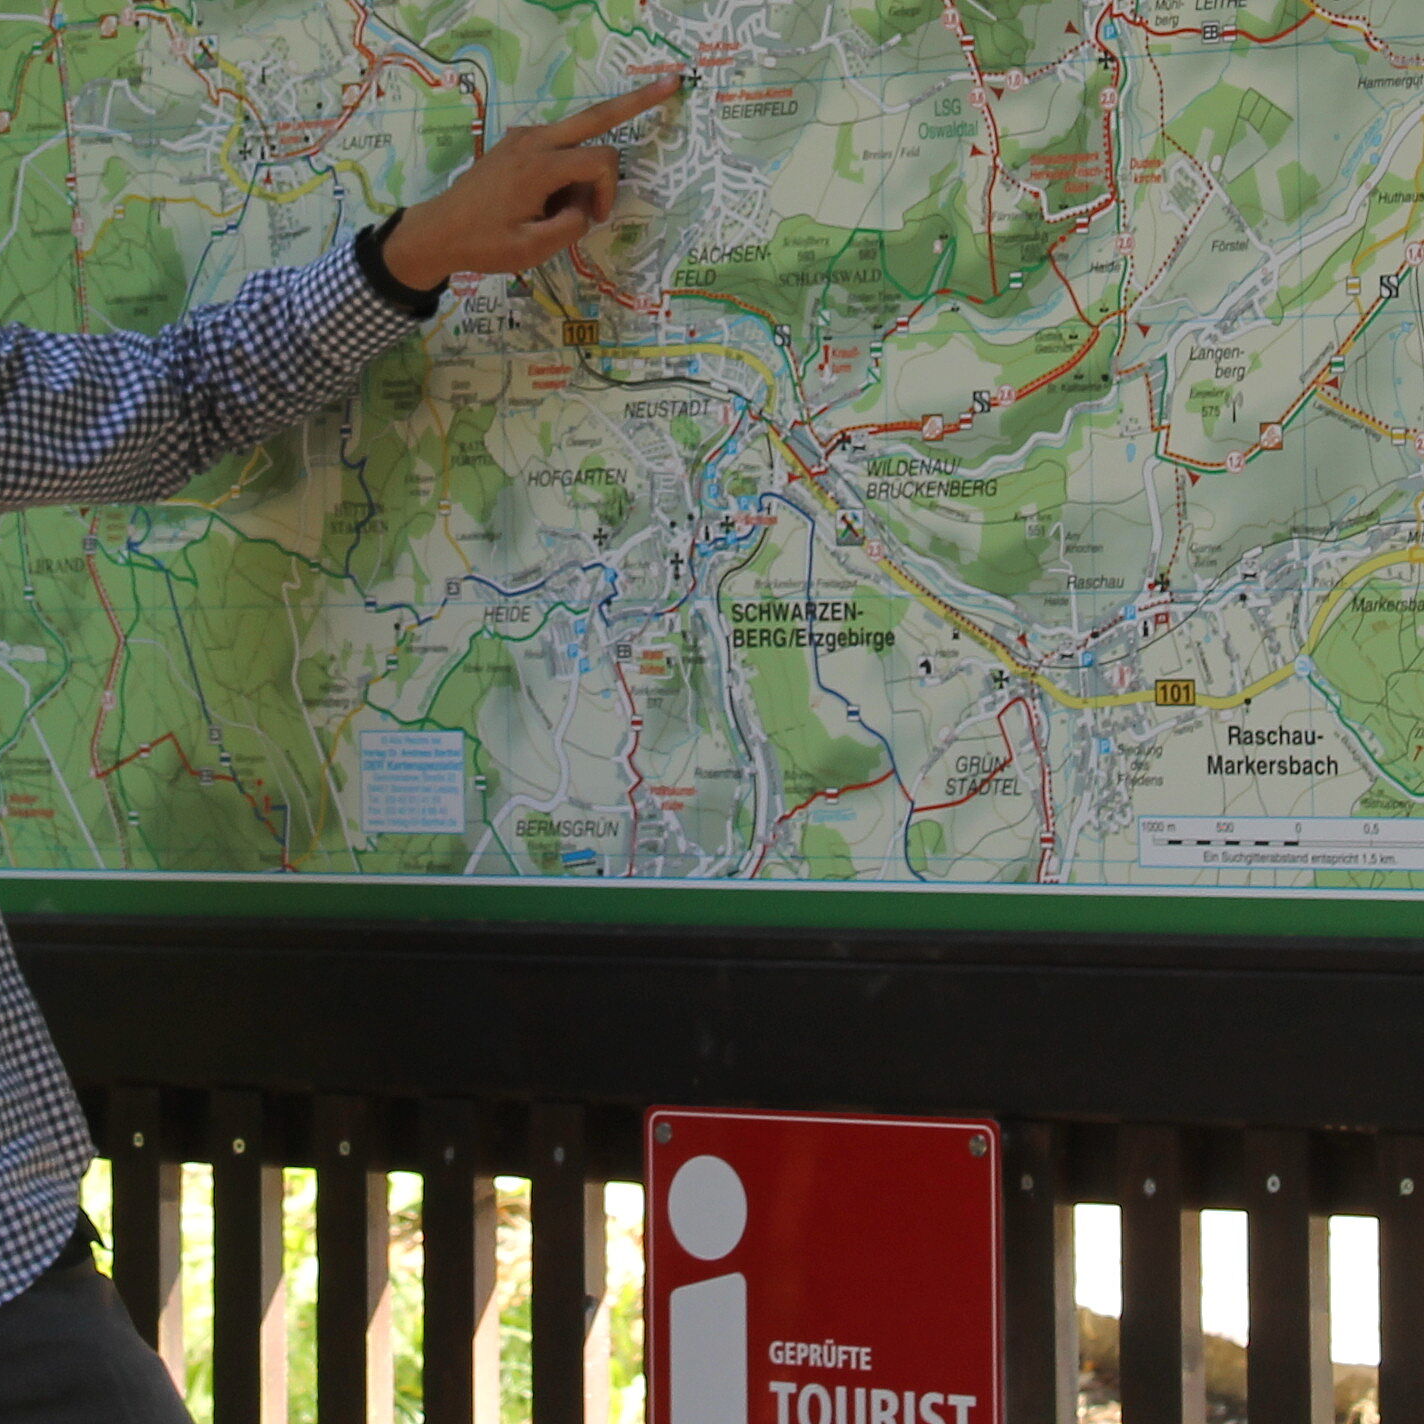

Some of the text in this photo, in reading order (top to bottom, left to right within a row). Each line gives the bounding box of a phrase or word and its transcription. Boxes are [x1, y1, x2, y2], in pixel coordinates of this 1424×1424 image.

[1357, 74, 1424, 90] Hammergut
[722, 99, 799, 120] BEIERFELD
[934, 98, 962, 117] LSG
[918, 120, 979, 139] Oswaldtal
[342, 132, 393, 152] LAUTER
[1378, 191, 1424, 205] Huthaus
[688, 244, 771, 265] SACHSEN-
[1211, 239, 1250, 253] Förstel
[676, 269, 717, 287] FELD
[1189, 346, 1245, 364] Langen-
[1216, 362, 1246, 380] berg
[624, 399, 711, 420] NEUSTADT
[1201, 406, 1221, 418] 575
[528, 467, 627, 488] HOFGARTEN
[866, 457, 962, 478] WILDENAU/
[866, 477, 998, 500] BRÜCKENBERG
[1067, 575, 1125, 590] Raschau
[483, 606, 531, 625] HEIDE
[732, 602, 864, 624] SCHWARZEN-
[732, 626, 896, 650] BERG/Erzgebirge
[1159, 683, 1192, 703] 101
[1228, 725, 1325, 745] Raschau-
[955, 755, 1010, 775] GRÜN-
[1206, 755, 1339, 776] Markersbach
[945, 775, 1022, 797] STÄDTEL
[516, 818, 619, 839] BERMSGRÜN
[769, 1339, 872, 1371] GEPRÜFTE
[769, 1380, 977, 1424] TOURIST
